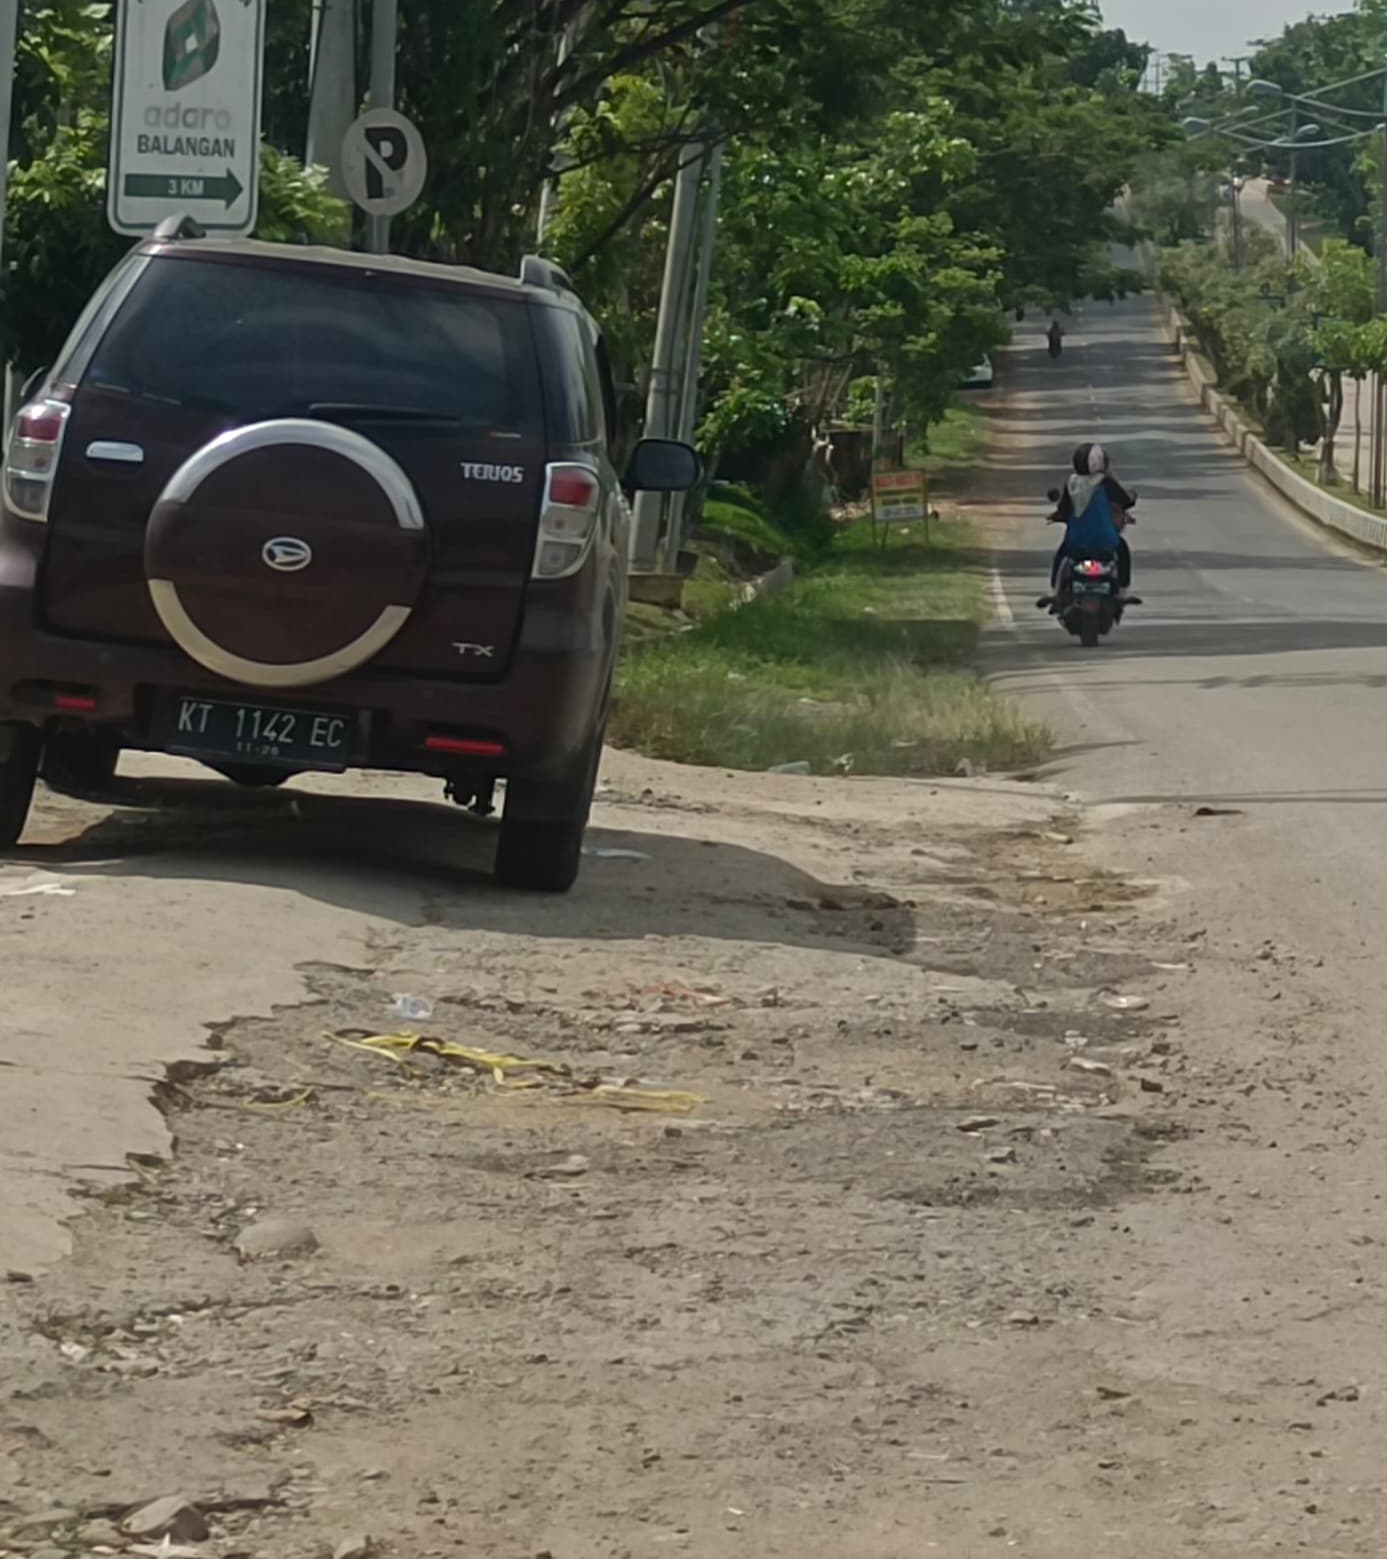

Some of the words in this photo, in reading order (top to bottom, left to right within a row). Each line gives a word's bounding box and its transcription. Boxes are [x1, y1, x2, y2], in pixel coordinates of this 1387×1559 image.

[144, 102, 232, 131] adaro
[137, 134, 235, 158] BALANGAN
[364, 126, 408, 200] P
[167, 179, 177, 194] 3
[180, 180, 204, 196] KM
[460, 462, 524, 483] TERIOS
[452, 642, 495, 657] TX
[178, 701, 213, 733] KT
[236, 708, 296, 743] 1142
[310, 717, 344, 747] EC
